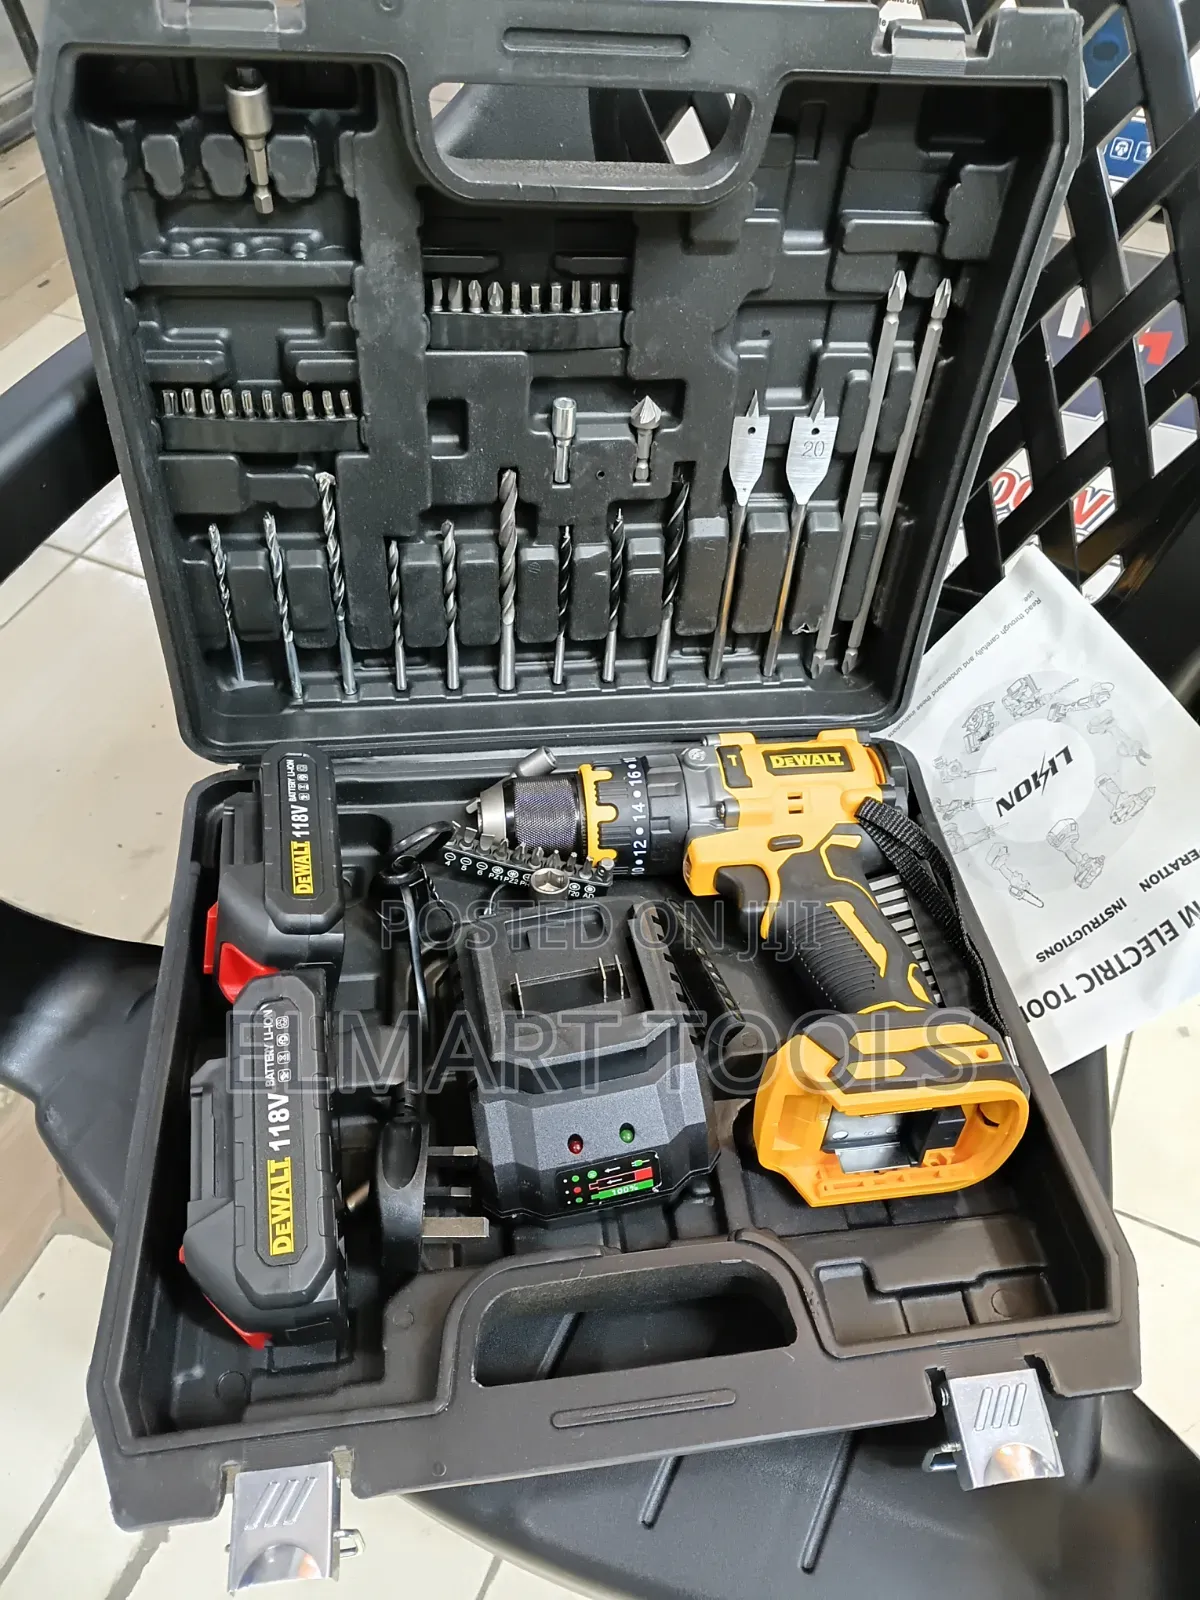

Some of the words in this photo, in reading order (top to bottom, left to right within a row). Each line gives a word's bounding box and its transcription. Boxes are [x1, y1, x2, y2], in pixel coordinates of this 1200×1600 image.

[803, 440, 825, 457] 20
[1024, 597, 1042, 615] Read
[1000, 613, 1025, 635] through
[975, 634, 1000, 657] carefully
[963, 656, 974, 668] and
[931, 667, 962, 697] understand
[916, 696, 931, 710] these
[887, 710, 916, 738] instructions
[769, 752, 844, 769] DEWALT
[288, 778, 297, 802] BATTERY
[627, 770, 643, 787] 16
[290, 804, 310, 839] 118V
[631, 802, 647, 822] 14
[633, 839, 647, 857] 12
[291, 841, 313, 894] DEWALT
[488, 872, 503, 881] PZ1
[503, 876, 519, 885] PZ2
[1138, 848, 1200, 893] ERATION
[1036, 897, 1128, 963] INSTRUCTIONS
[1075, 919, 1180, 994] ELECTRIC
[262, 1010, 273, 1042] LI-ION
[264, 1044, 276, 1087] BATTERY
[268, 1093, 291, 1151] 118V
[611, 1183, 639, 1196] 100%
[268, 1157, 294, 1256] DEWALT
